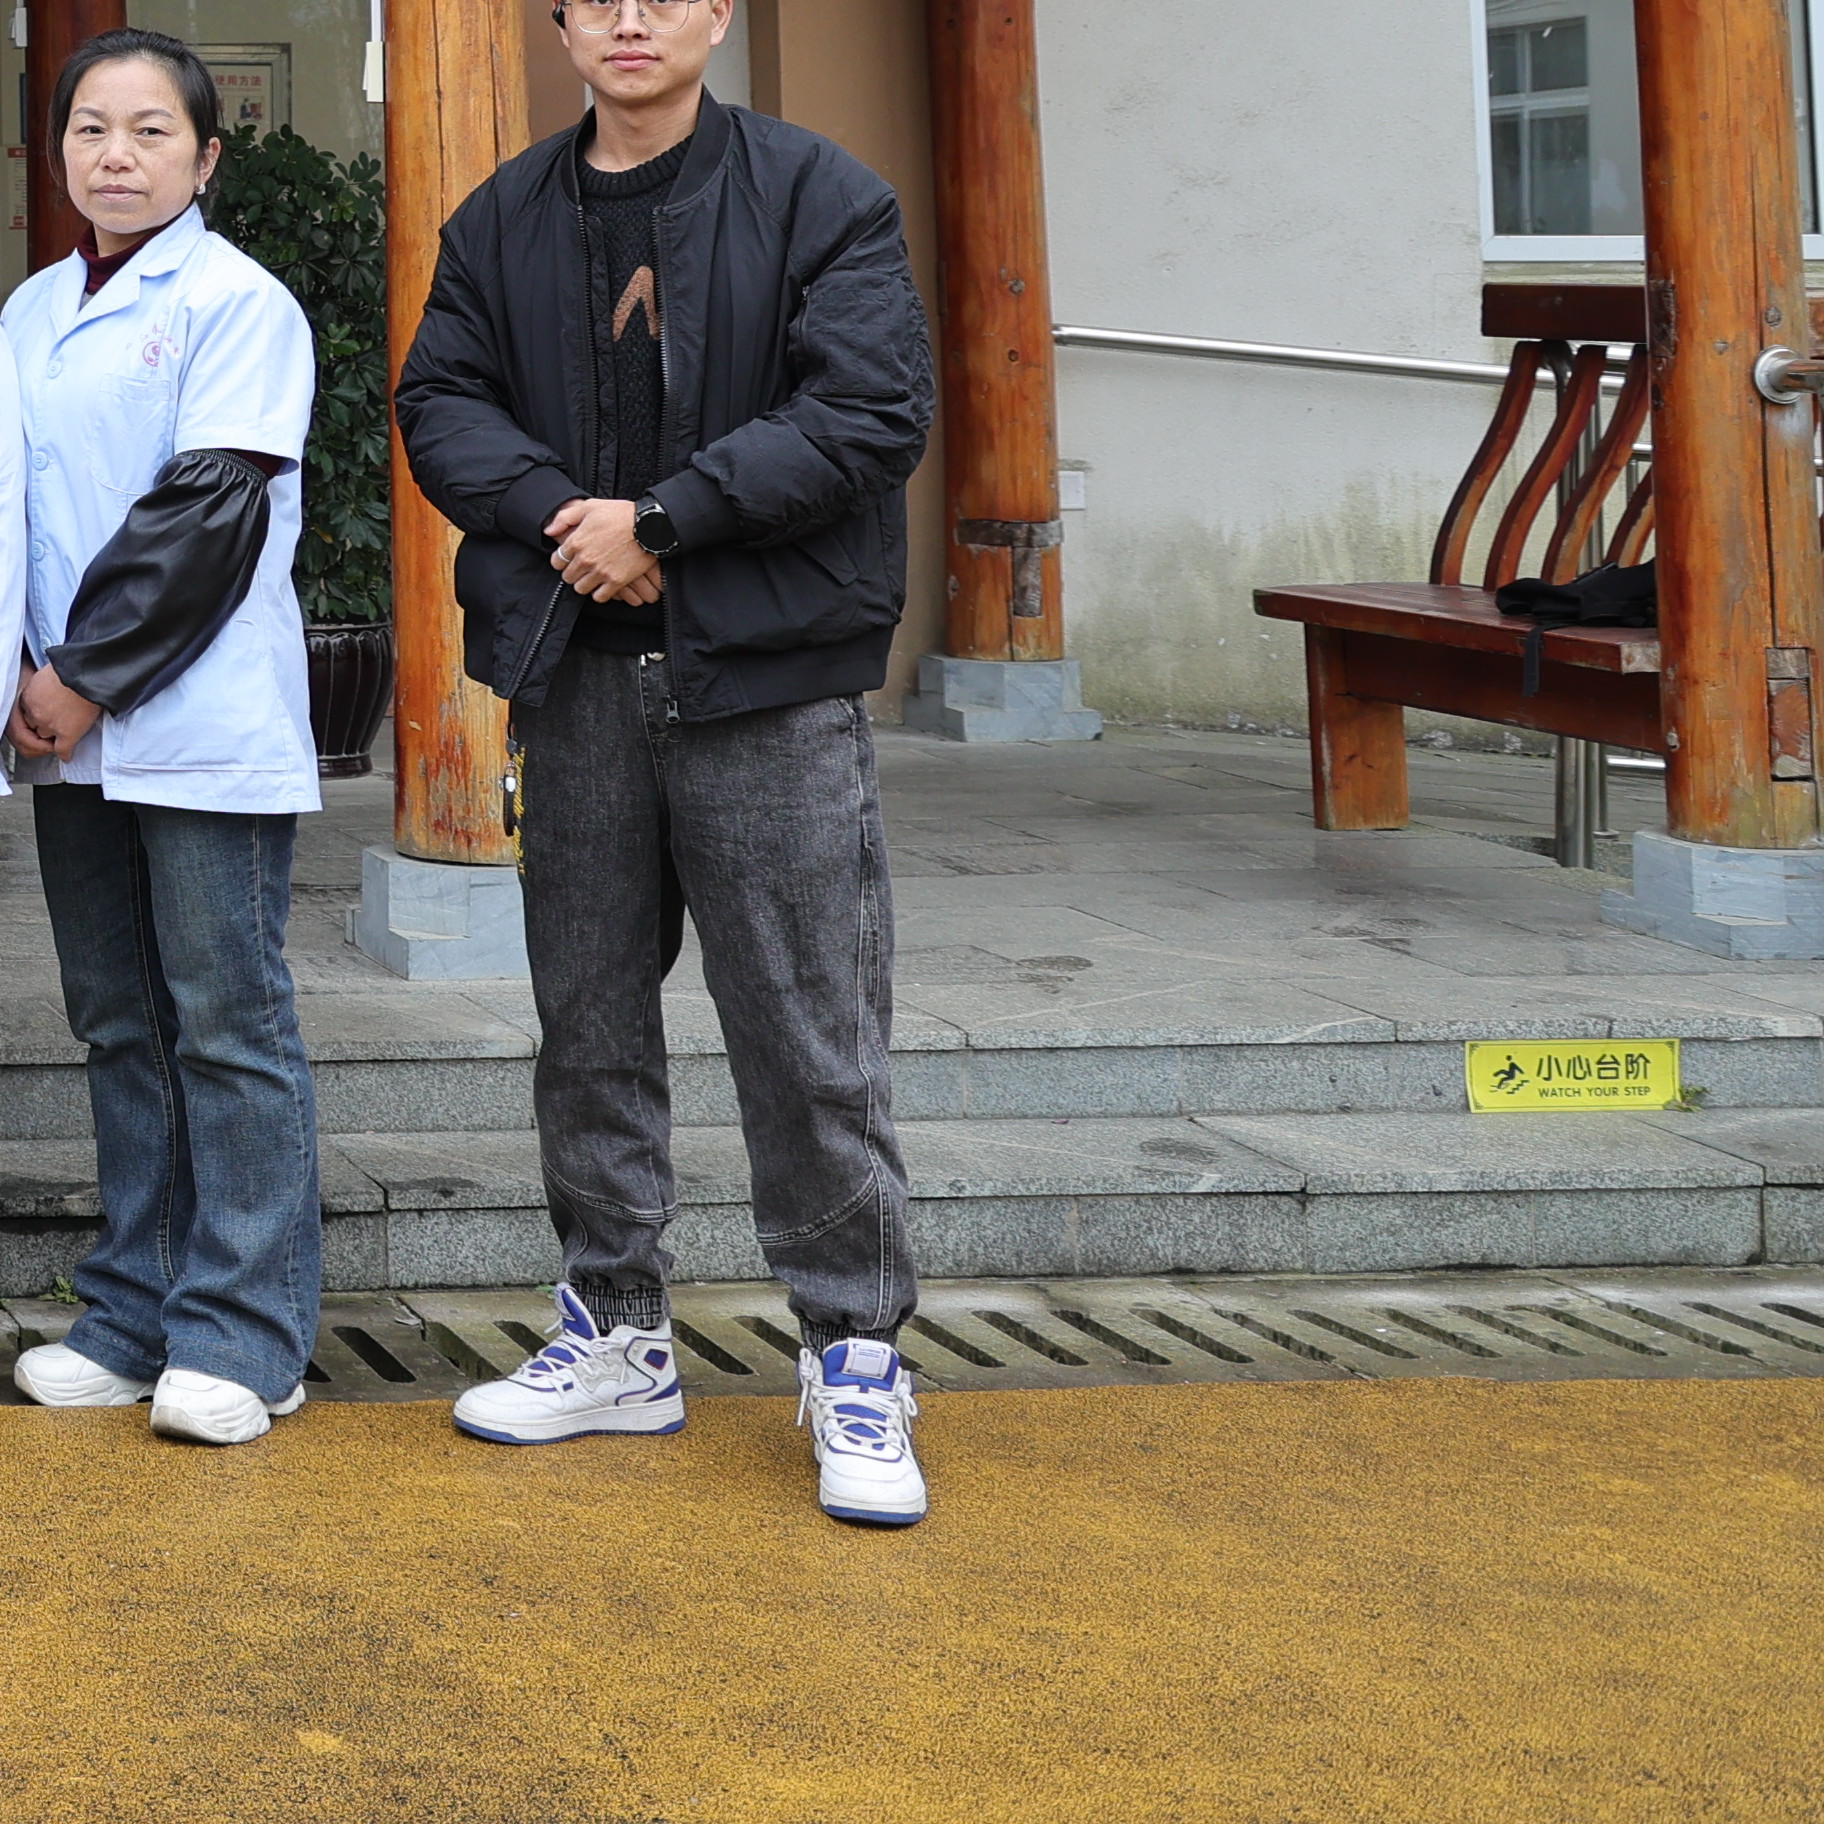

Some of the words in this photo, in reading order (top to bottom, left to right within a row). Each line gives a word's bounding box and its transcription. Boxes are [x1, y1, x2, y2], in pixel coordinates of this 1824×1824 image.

[1536, 1053, 1651, 1081] 小心台阶
[1538, 1087, 1581, 1098] WATCH
[1586, 1087, 1619, 1097] YOUR
[1624, 1086, 1651, 1096] STEP
